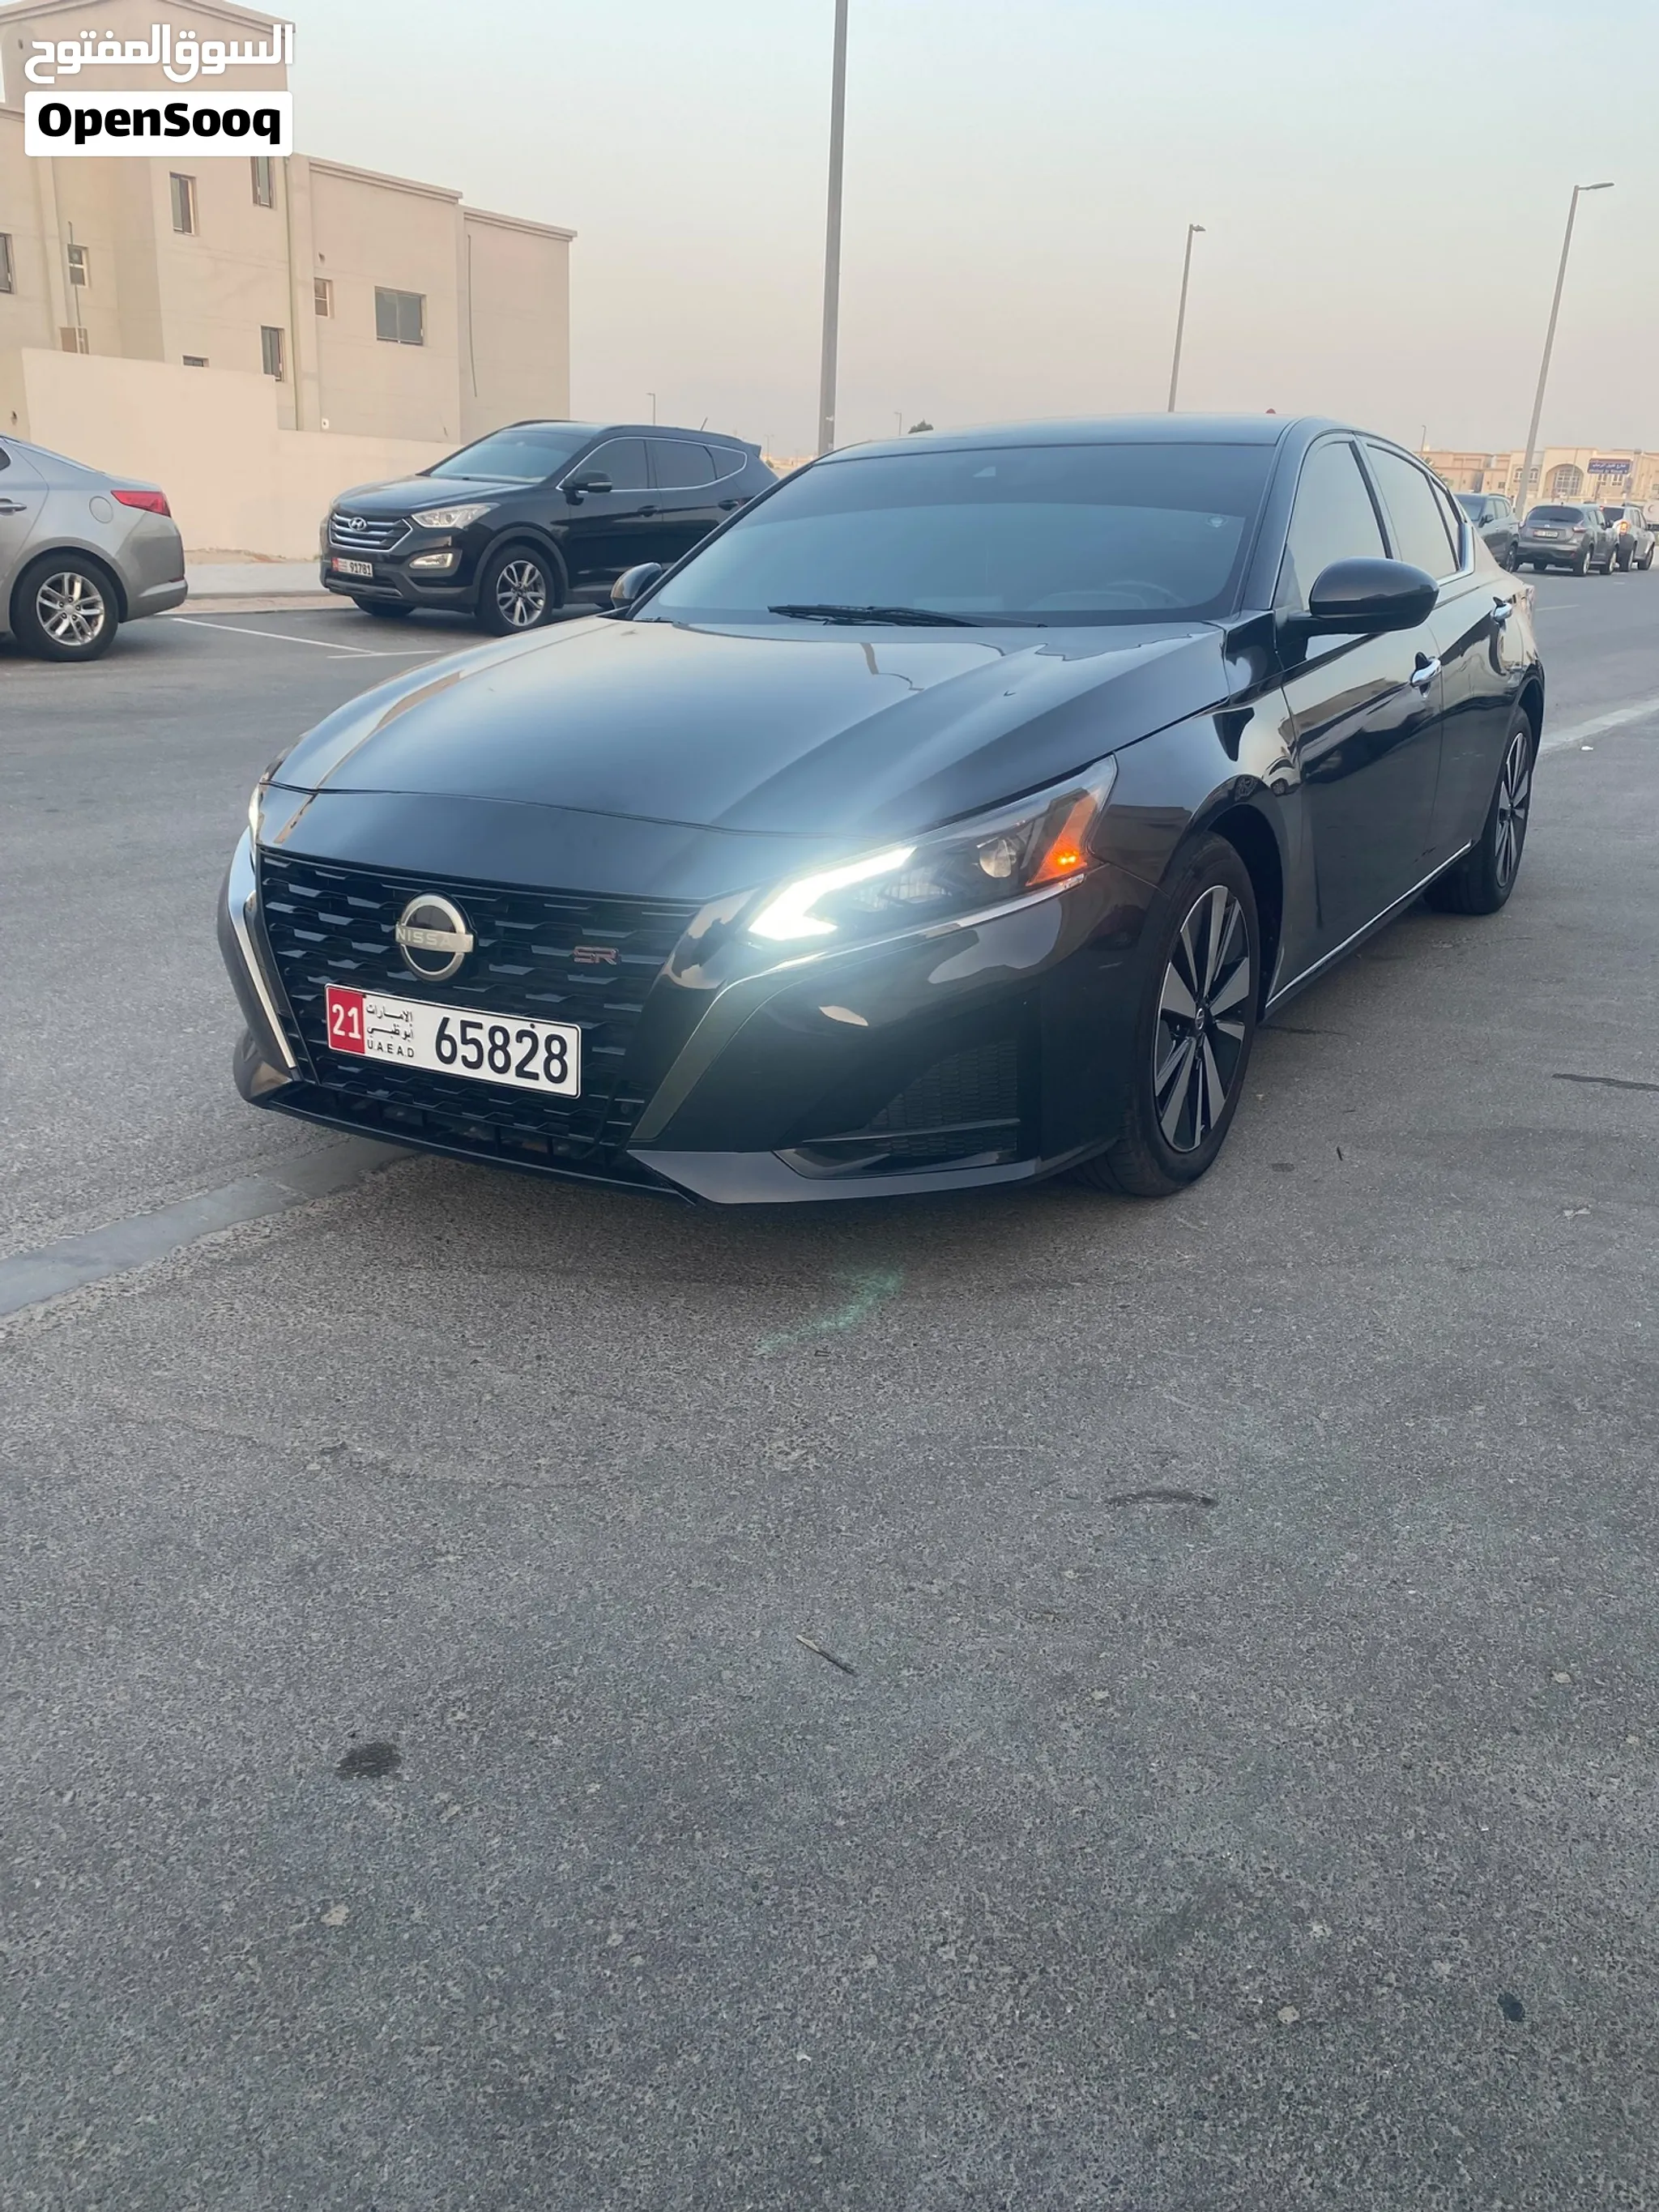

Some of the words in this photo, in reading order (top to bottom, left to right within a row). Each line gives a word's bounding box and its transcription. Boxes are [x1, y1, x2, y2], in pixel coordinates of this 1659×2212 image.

[574, 946, 619, 965] SR
[331, 1004, 361, 1040] 21
[434, 1016, 569, 1085] 65828
